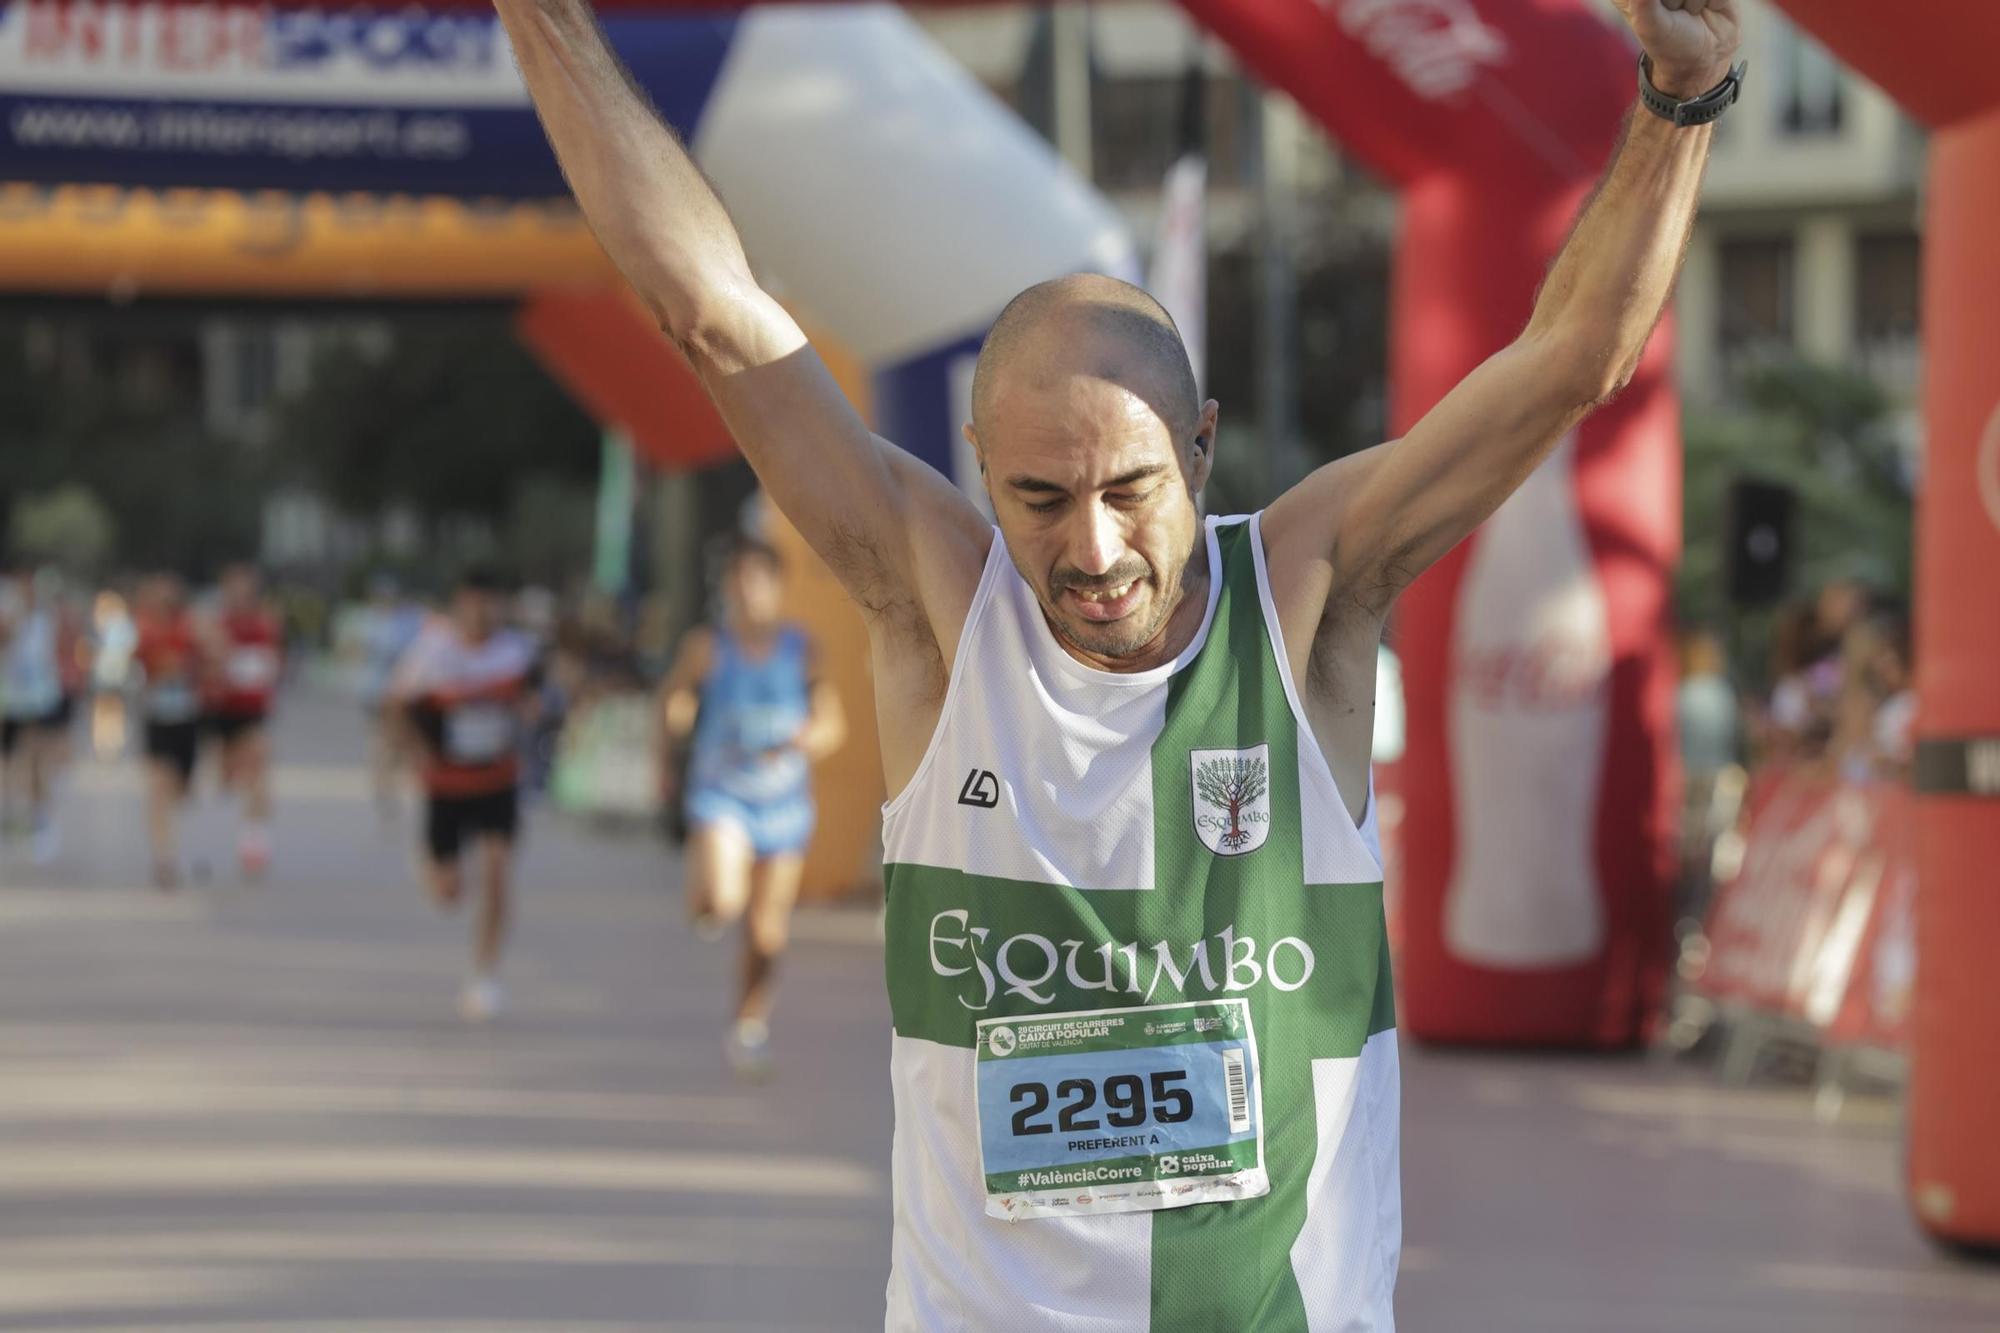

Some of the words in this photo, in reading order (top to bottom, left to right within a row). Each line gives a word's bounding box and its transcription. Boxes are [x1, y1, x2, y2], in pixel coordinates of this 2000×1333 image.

[1028, 1023, 1062, 1034] CIRCUIT
[1063, 1022, 1076, 1030] DE
[1075, 1018, 1125, 1030] CARRERES
[1018, 1031, 1055, 1043] CAIXA
[1055, 1027, 1110, 1040] POPULAR
[1009, 1070, 1194, 1136] 2295
[1068, 1135, 1146, 1151] PREFERENT
[1149, 1134, 1160, 1144] A
[1181, 1153, 1215, 1164] caixa
[1182, 1159, 1234, 1173] popular
[1017, 1166, 1143, 1187] #ValènciaCorre
